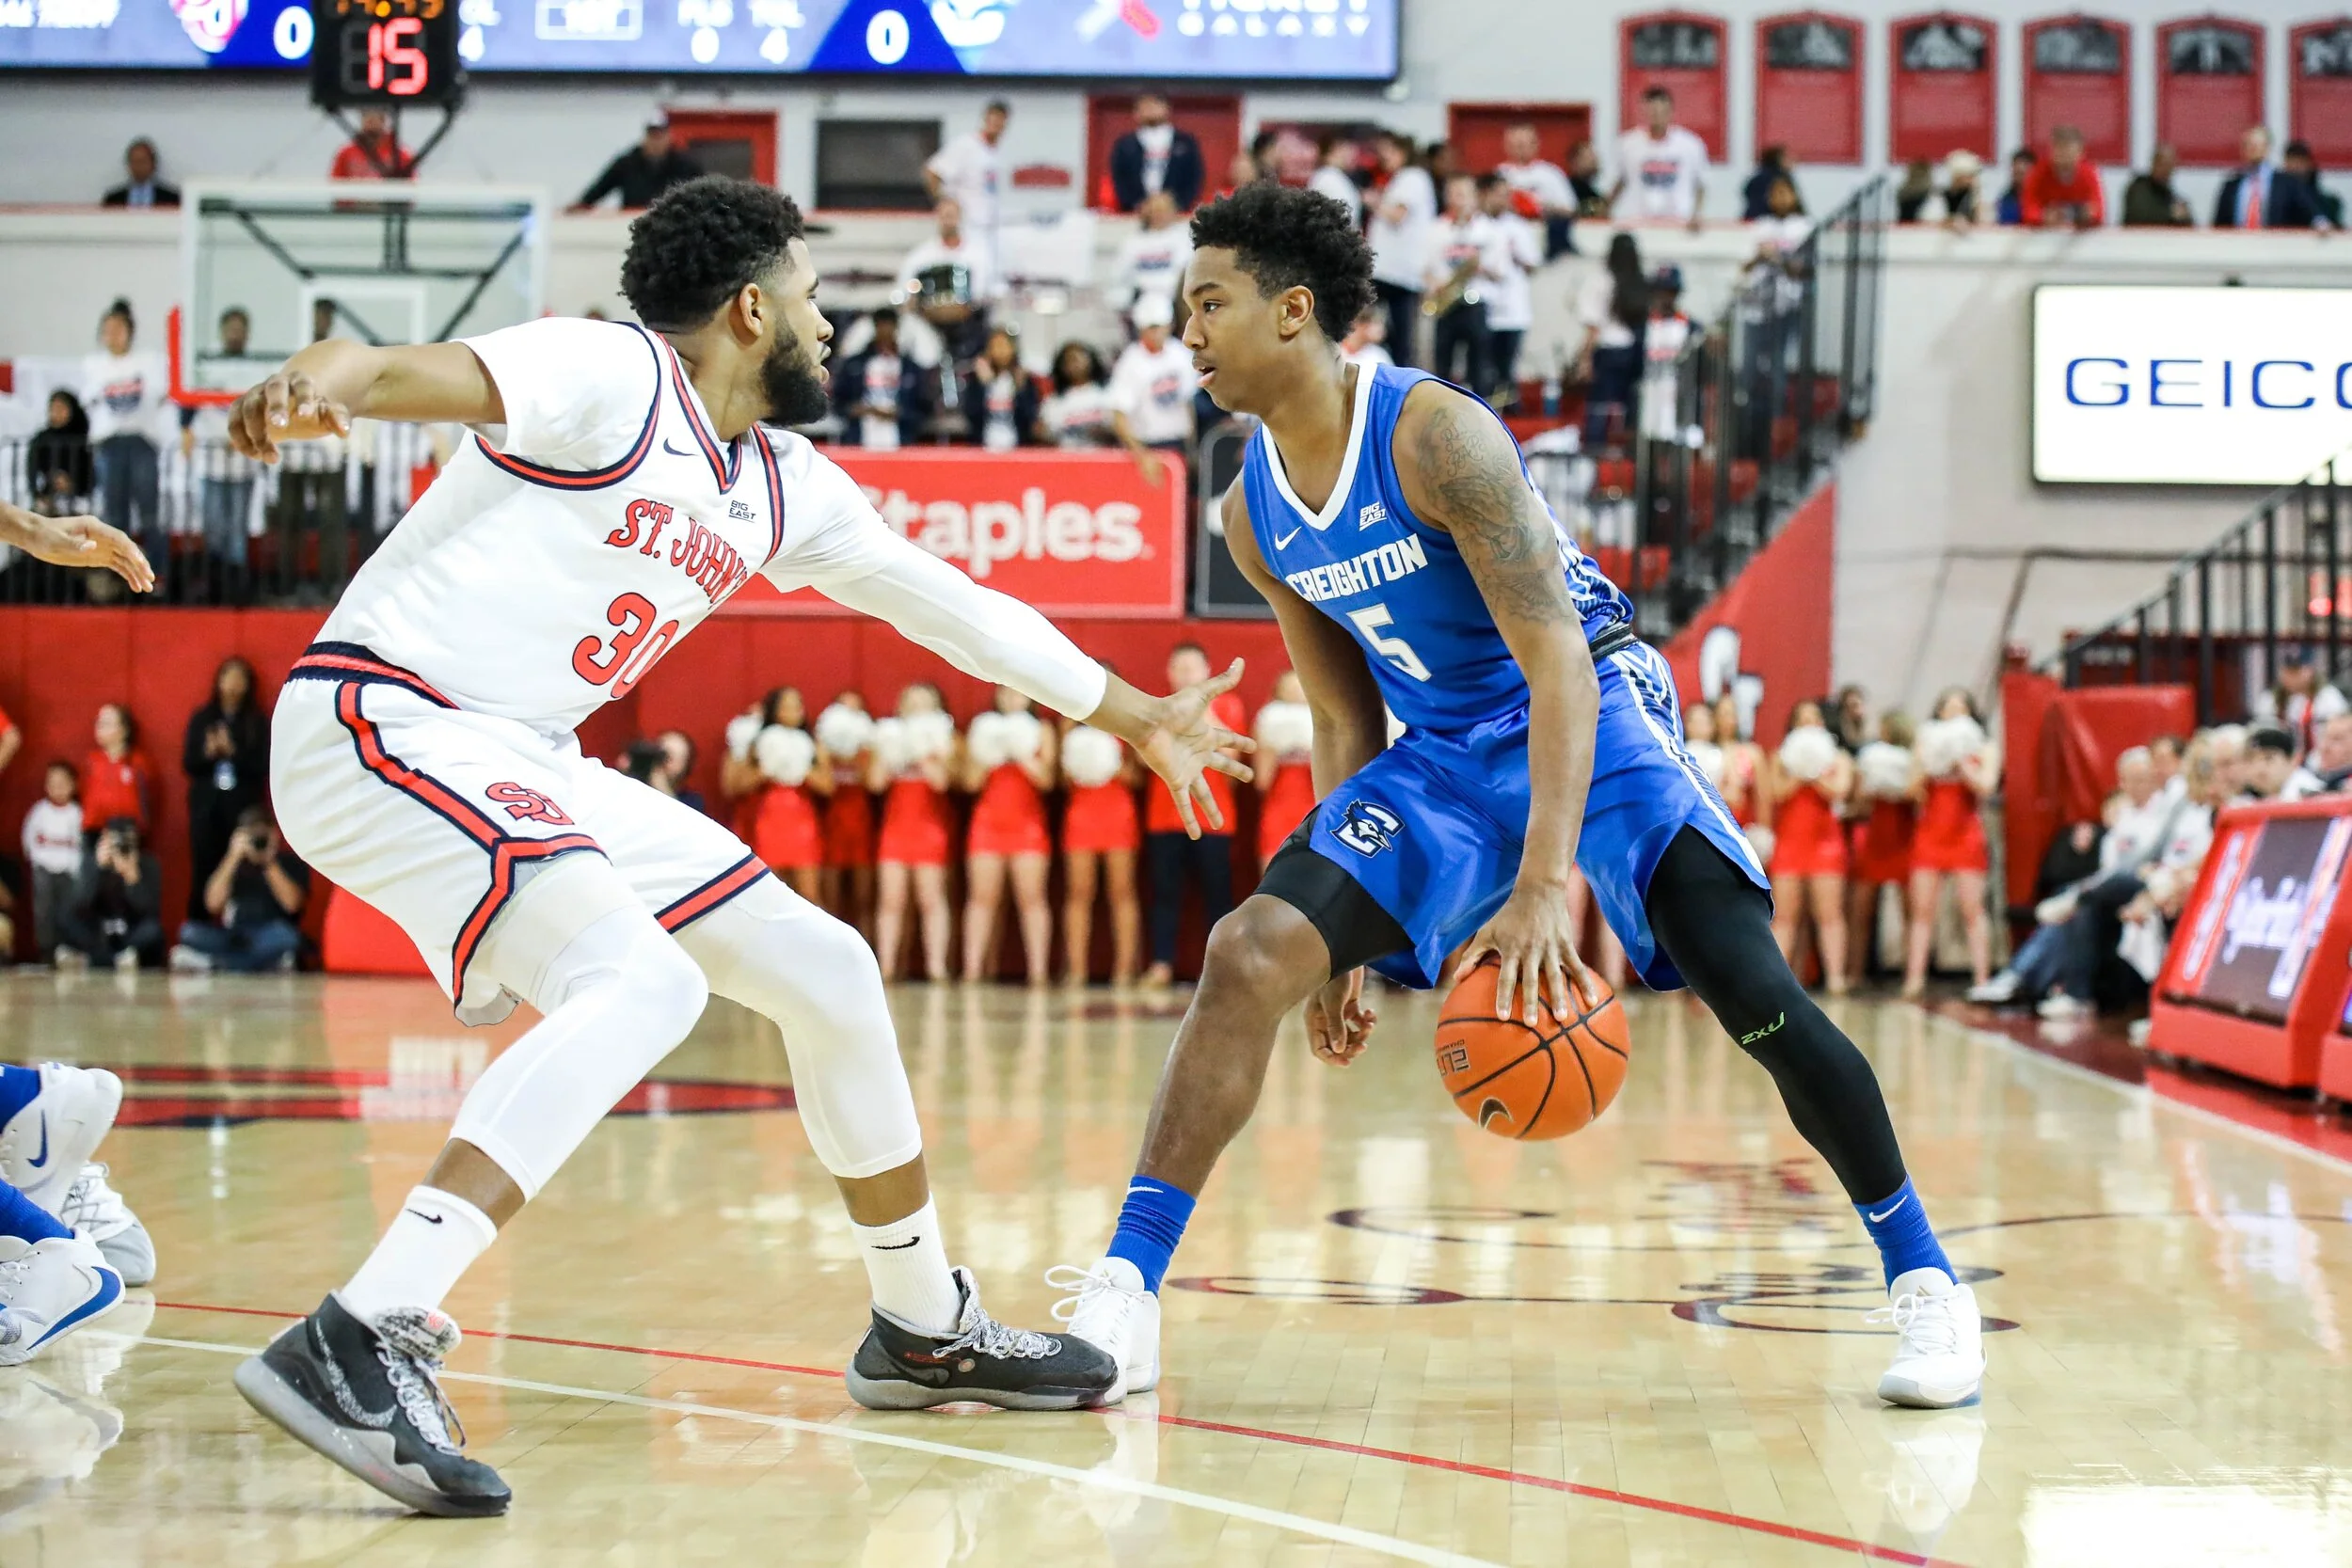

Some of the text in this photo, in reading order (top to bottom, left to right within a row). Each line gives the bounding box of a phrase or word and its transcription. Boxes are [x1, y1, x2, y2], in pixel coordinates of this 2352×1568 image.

[274, 6, 314, 59] 0
[368, 17, 428, 94] 15
[866, 9, 909, 64] 0
[2065, 357, 2352, 409] GEIC
[603, 498, 674, 559] ST.
[729, 507, 756, 520] EAST
[730, 499, 749, 511] BIG
[860, 484, 1143, 579] taples
[1359, 508, 1387, 527] EAST
[1360, 500, 1380, 516] BIG
[1285, 533, 1428, 602] CREIGHTON
[572, 592, 679, 699] 30
[1346, 603, 1432, 682] 5
